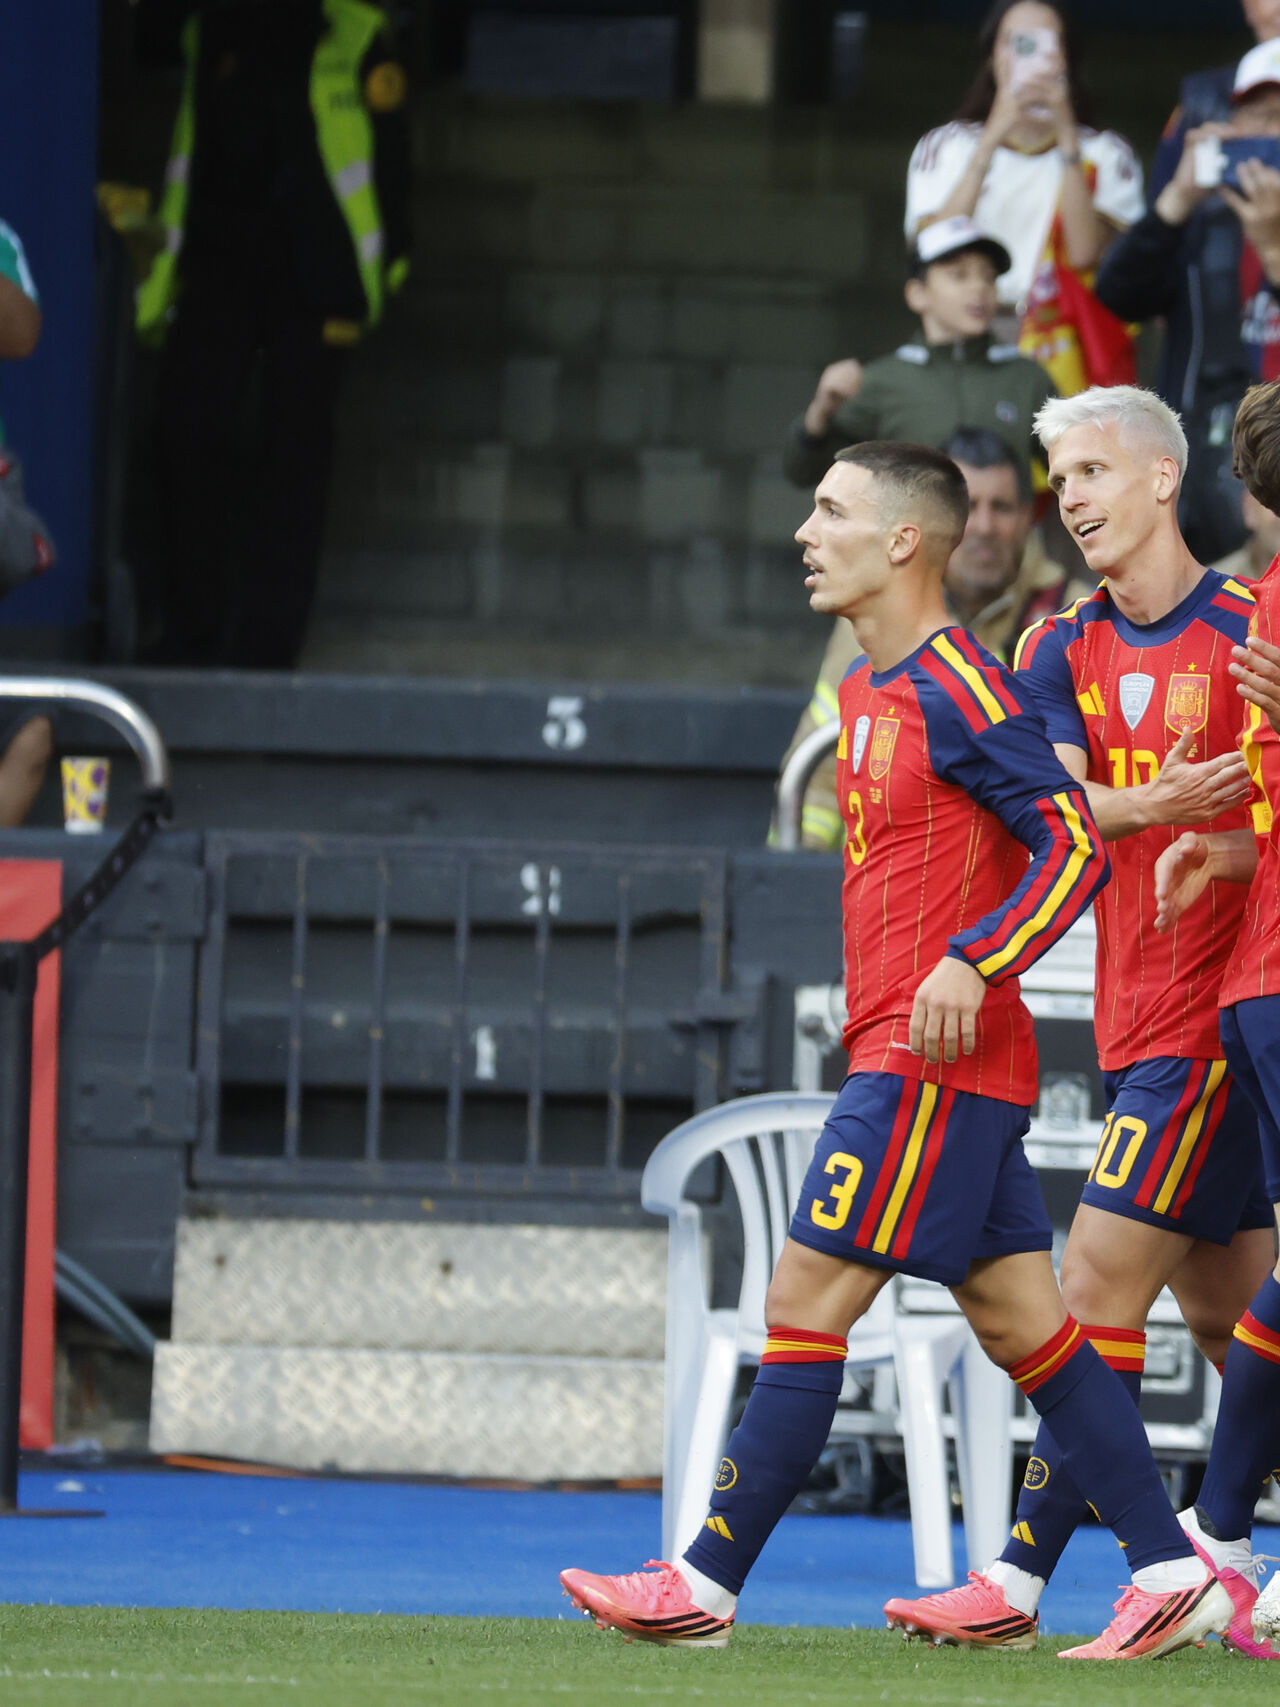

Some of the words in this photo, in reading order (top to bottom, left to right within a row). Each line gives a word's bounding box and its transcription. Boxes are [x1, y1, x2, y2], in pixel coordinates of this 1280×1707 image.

[848, 790, 867, 866] 3
[475, 1026, 497, 1080] 1
[1088, 1111, 1147, 1189] 10
[810, 1152, 864, 1231] 3
